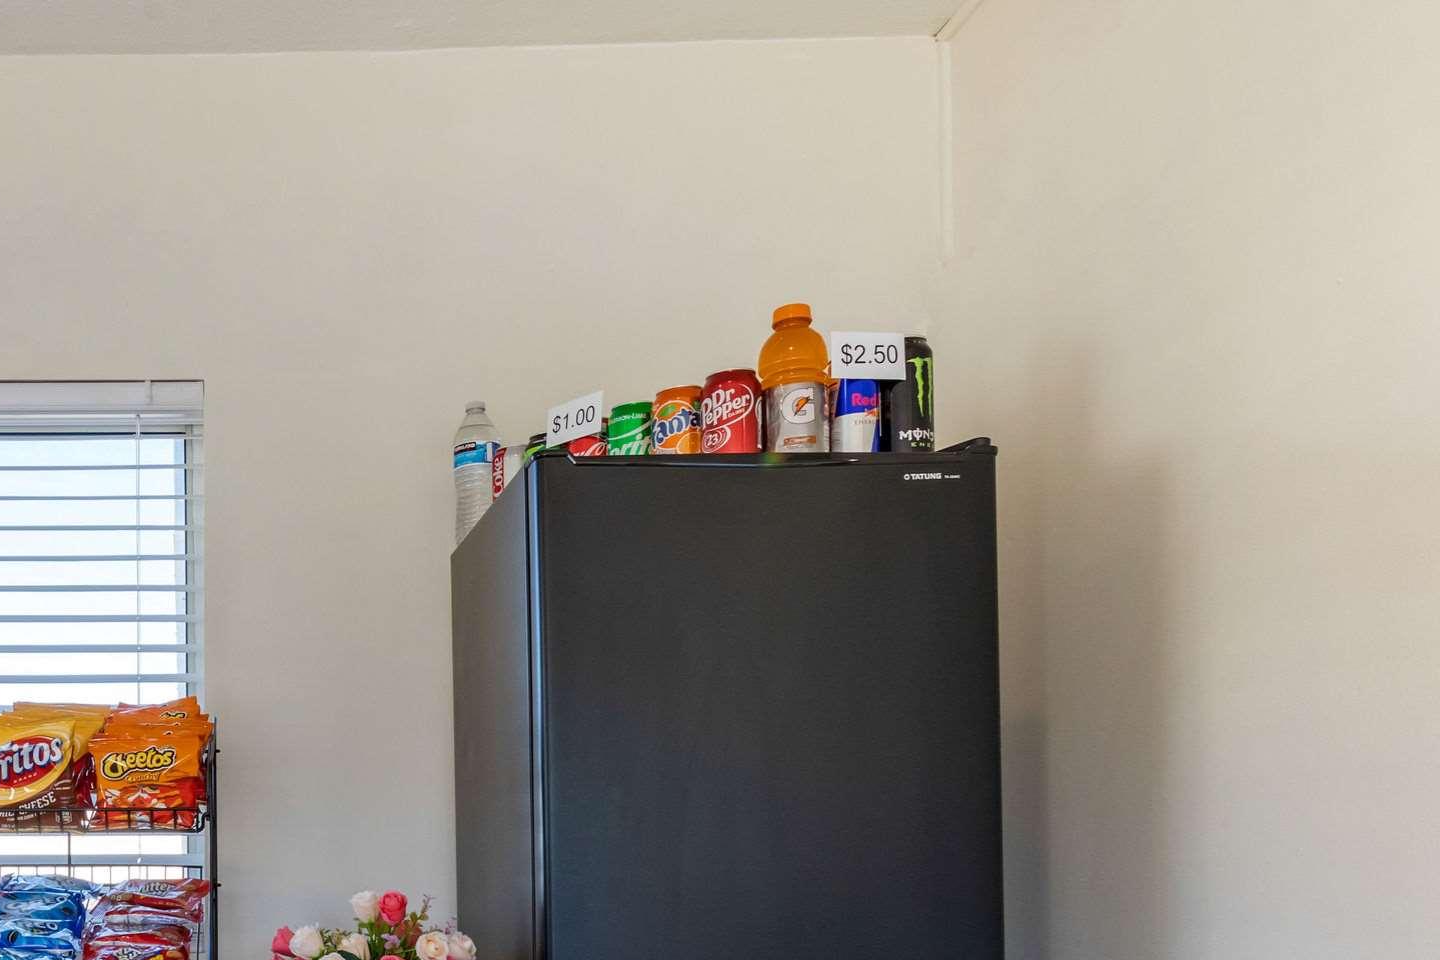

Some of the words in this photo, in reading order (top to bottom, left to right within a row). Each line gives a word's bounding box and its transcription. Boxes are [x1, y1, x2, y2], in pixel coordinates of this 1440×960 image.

[841, 344, 898, 366] $2.50
[712, 388, 736, 409] Dr
[851, 393, 880, 406] Red
[552, 405, 595, 434] $1.00
[701, 394, 750, 430] Pepper
[706, 434, 719, 447] 23
[911, 472, 942, 481] TATUNG
[102, 747, 176, 778] Cheetos
